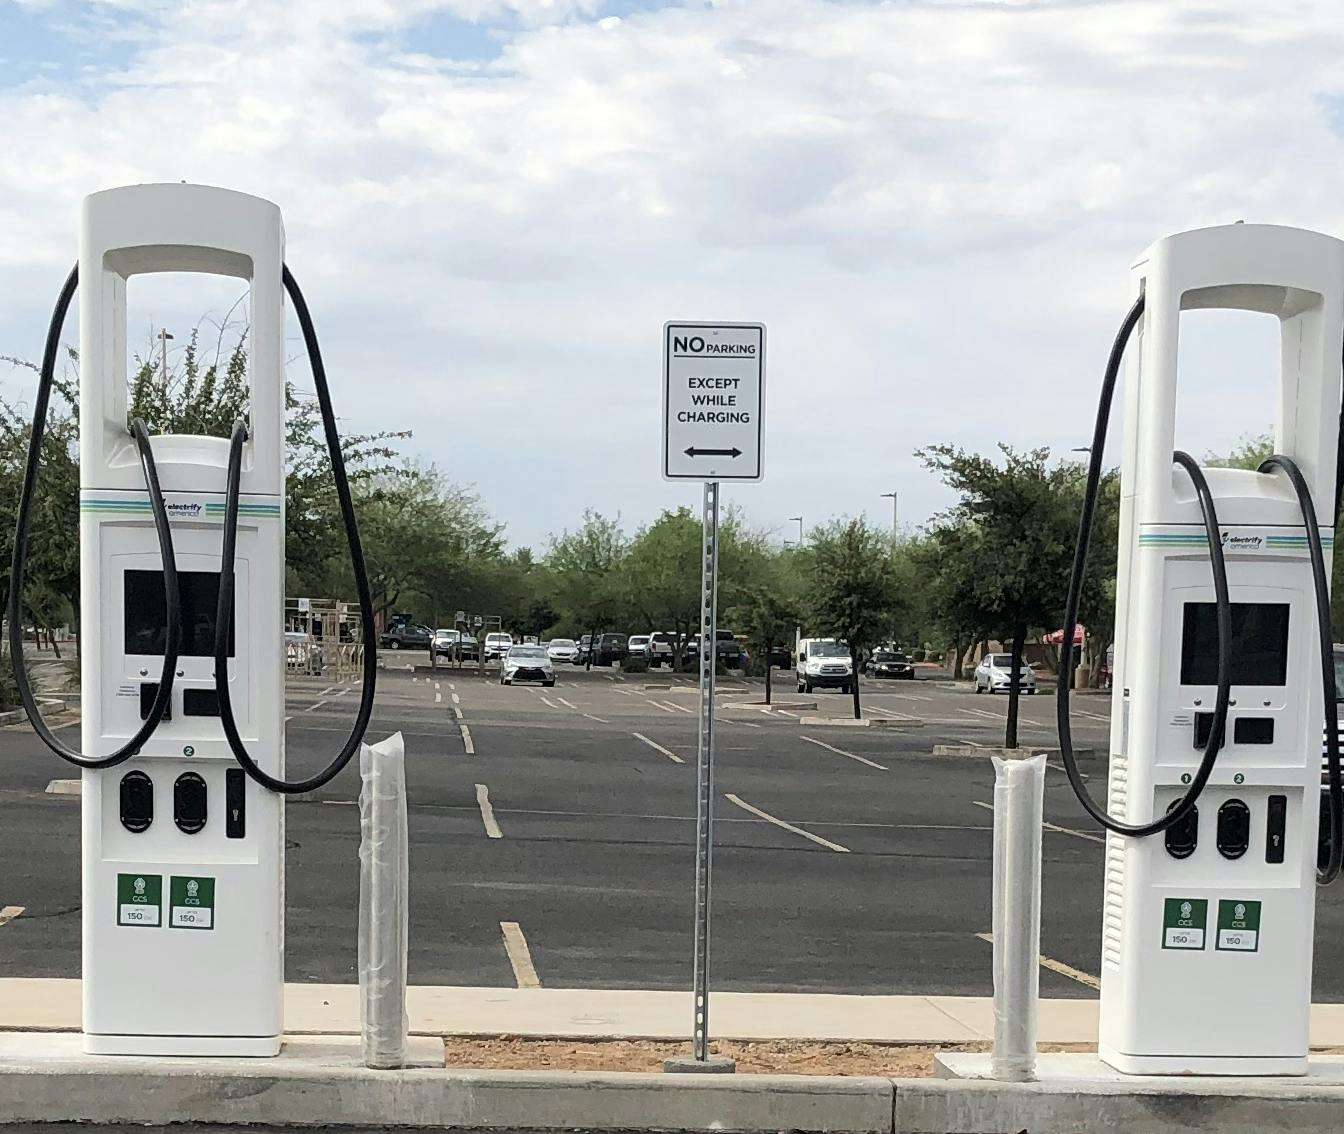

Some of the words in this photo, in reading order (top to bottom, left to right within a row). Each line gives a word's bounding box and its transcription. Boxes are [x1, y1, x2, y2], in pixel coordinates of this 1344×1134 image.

[673, 336, 705, 353] NO
[706, 344, 756, 354] PARKING
[688, 377, 740, 389] EXCEPT
[691, 395, 737, 406] WHILE
[677, 411, 750, 423] CHARGING
[127, 912, 143, 920] 150
[179, 914, 195, 922] 150
[1172, 935, 1188, 943] 150
